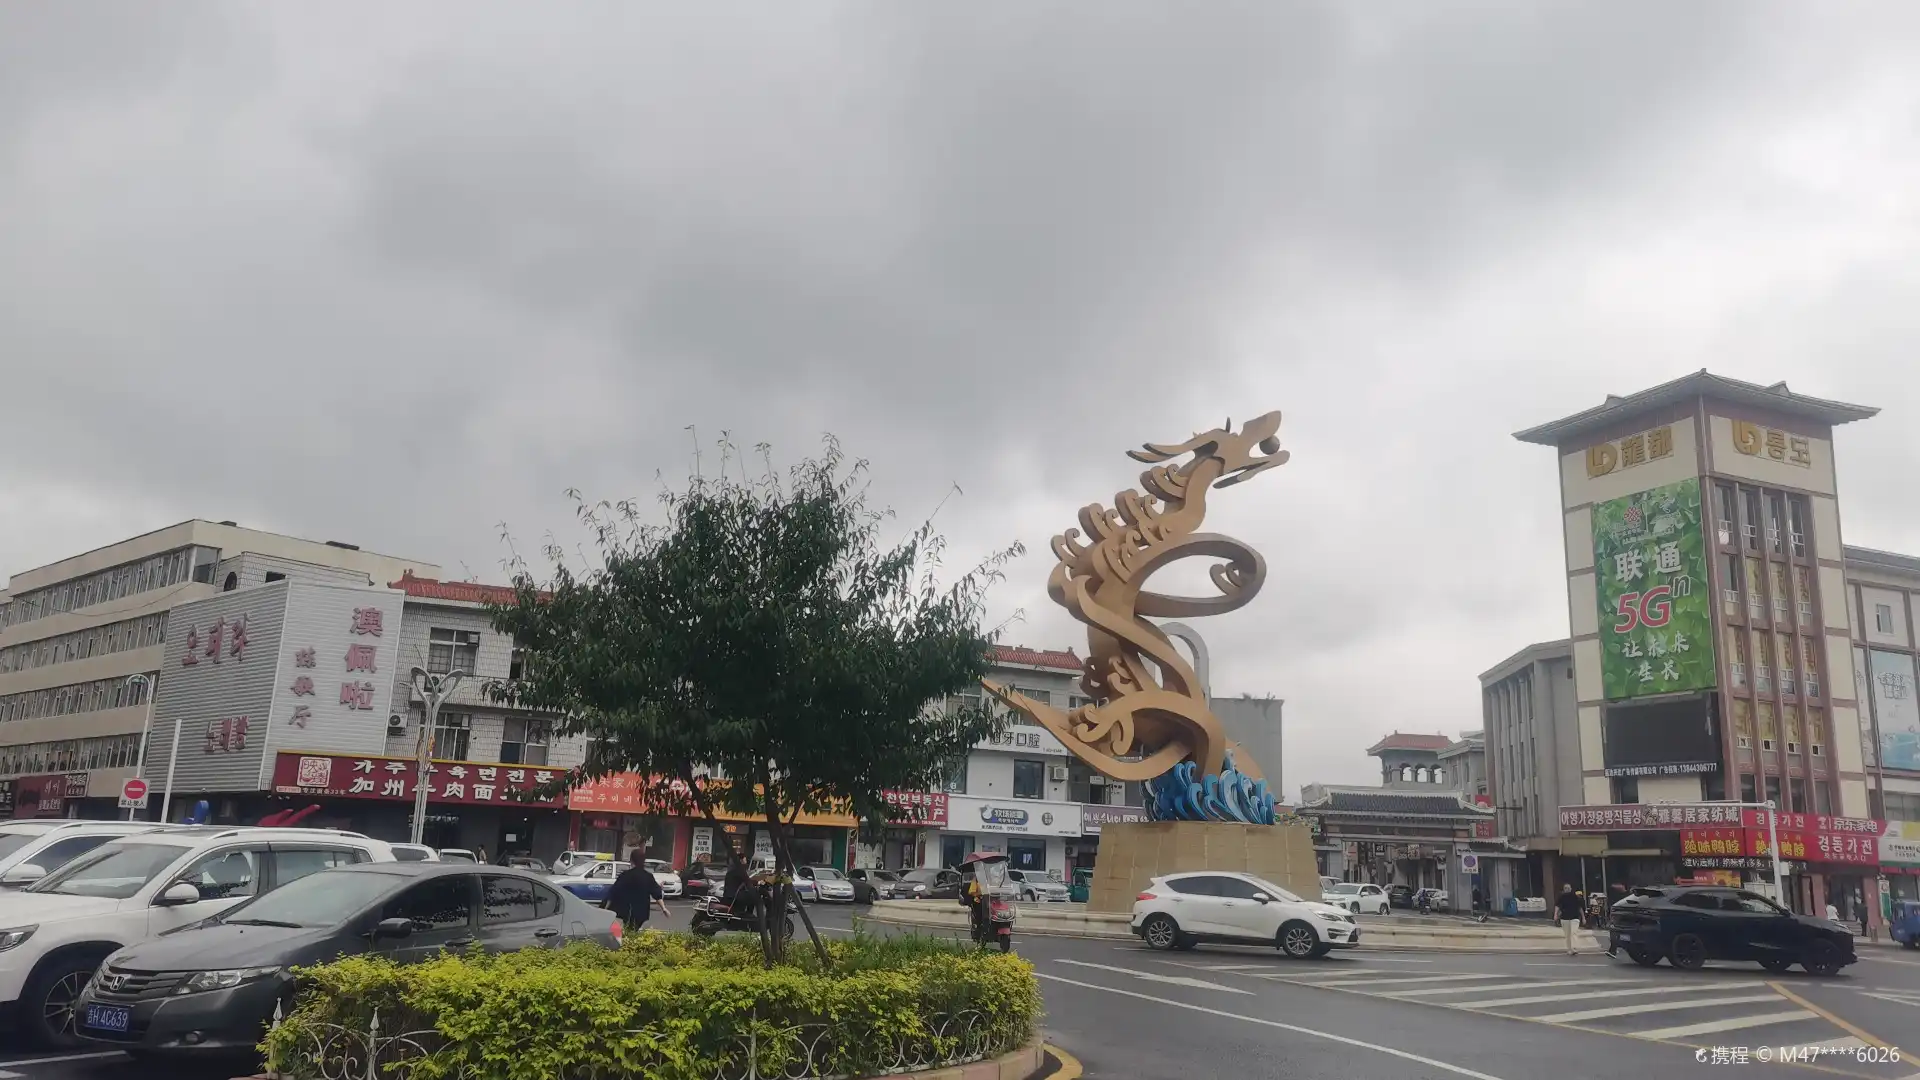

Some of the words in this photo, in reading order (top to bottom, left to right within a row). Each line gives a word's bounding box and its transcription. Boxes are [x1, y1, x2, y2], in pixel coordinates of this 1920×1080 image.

[1614, 541, 1682, 582] 联通
[1621, 630, 1690, 659] 让未来
[339, 607, 383, 710] 澳佩啦
[1637, 659, 1680, 682] 生长
[1832, 817, 1878, 833] 京东家电
[1684, 839, 1740, 854] 绝味鸭脖
[1755, 840, 1805, 857] 绝鸭脖
[1818, 835, 1873, 855] 경동가전
